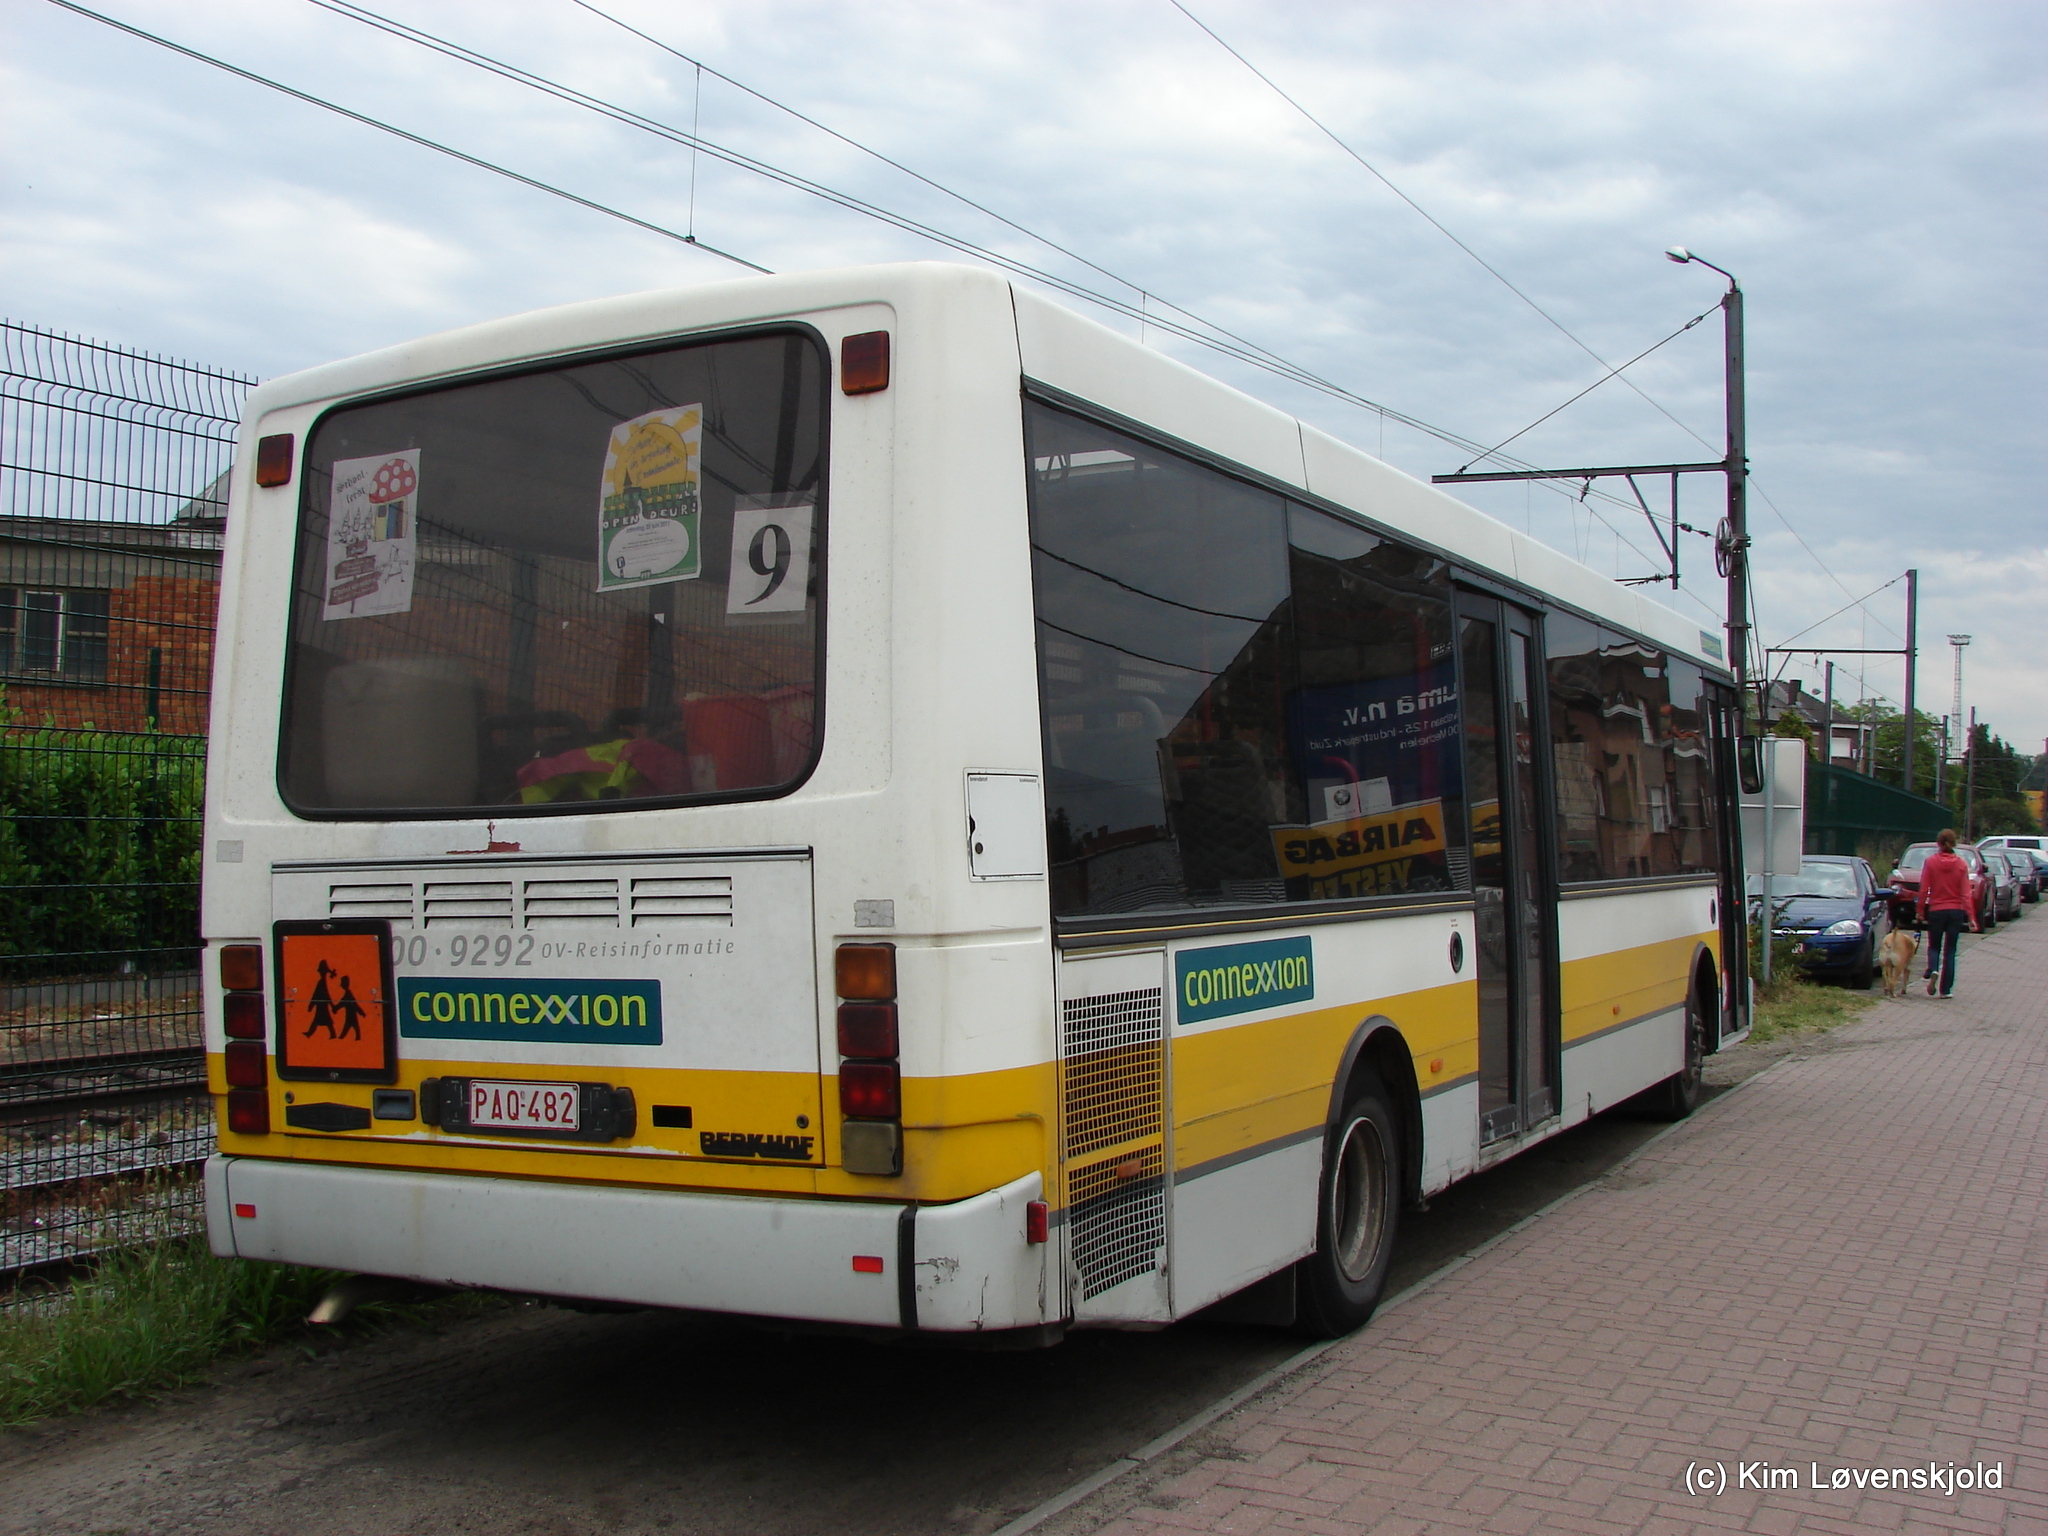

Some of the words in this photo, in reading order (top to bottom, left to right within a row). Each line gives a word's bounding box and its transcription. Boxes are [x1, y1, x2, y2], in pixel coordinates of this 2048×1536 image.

[602, 515, 640, 529] OPEN
[744, 524, 791, 605] 9
[541, 938, 735, 959] OV-Reisinformatie
[1184, 955, 1309, 1007] connexxion
[412, 990, 647, 1027] connexxion
